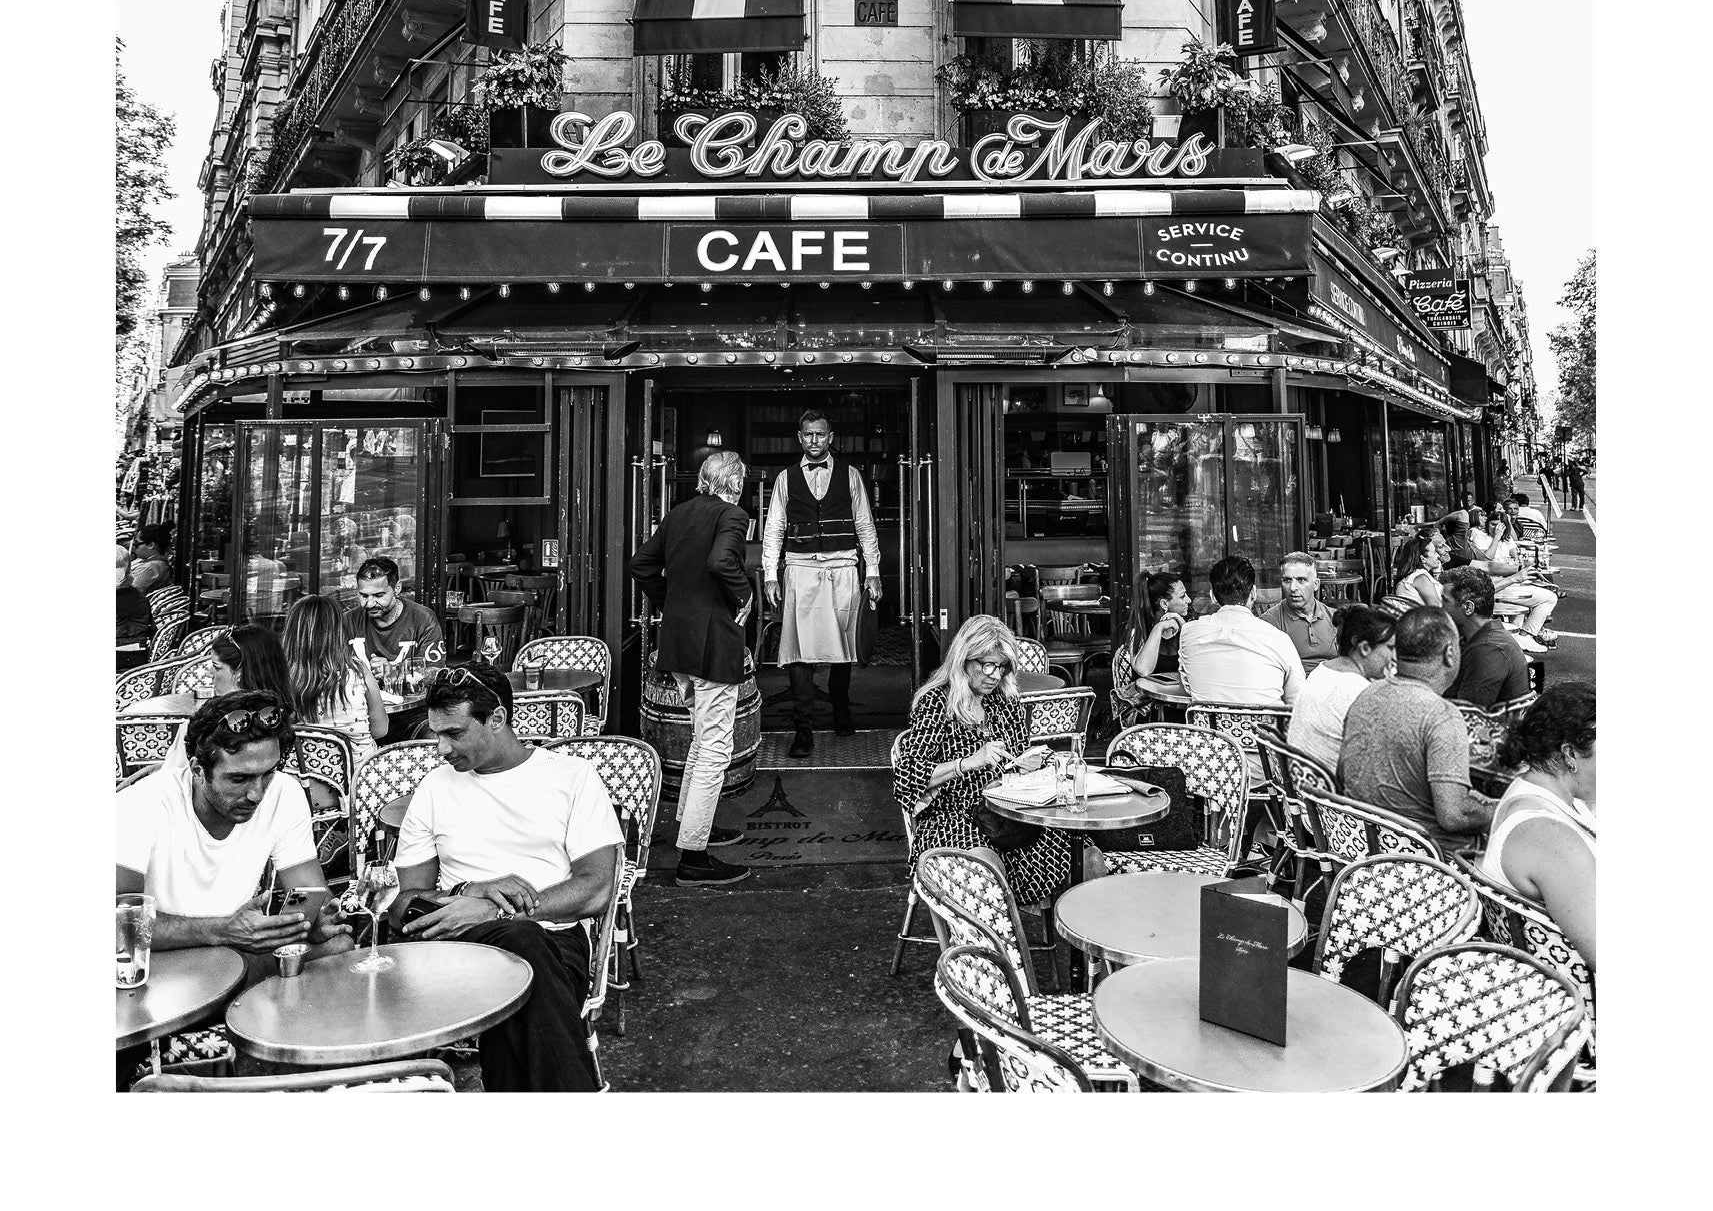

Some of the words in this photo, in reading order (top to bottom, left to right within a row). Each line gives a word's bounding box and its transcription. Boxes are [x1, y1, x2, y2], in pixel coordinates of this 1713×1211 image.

[541, 111, 666, 177] Le
[674, 111, 959, 183] Champ
[980, 136, 1024, 177] de
[1007, 113, 1217, 181] Mars
[1157, 223, 1244, 241] SERVICE
[324, 227, 387, 270] 7/7
[697, 230, 870, 272] CAFE
[1156, 247, 1249, 266] CONTINU
[1409, 278, 1452, 290] Pizzeria
[1413, 290, 1466, 313] Café
[746, 821, 812, 831] BISTROT
[842, 831, 907, 842] Ma
